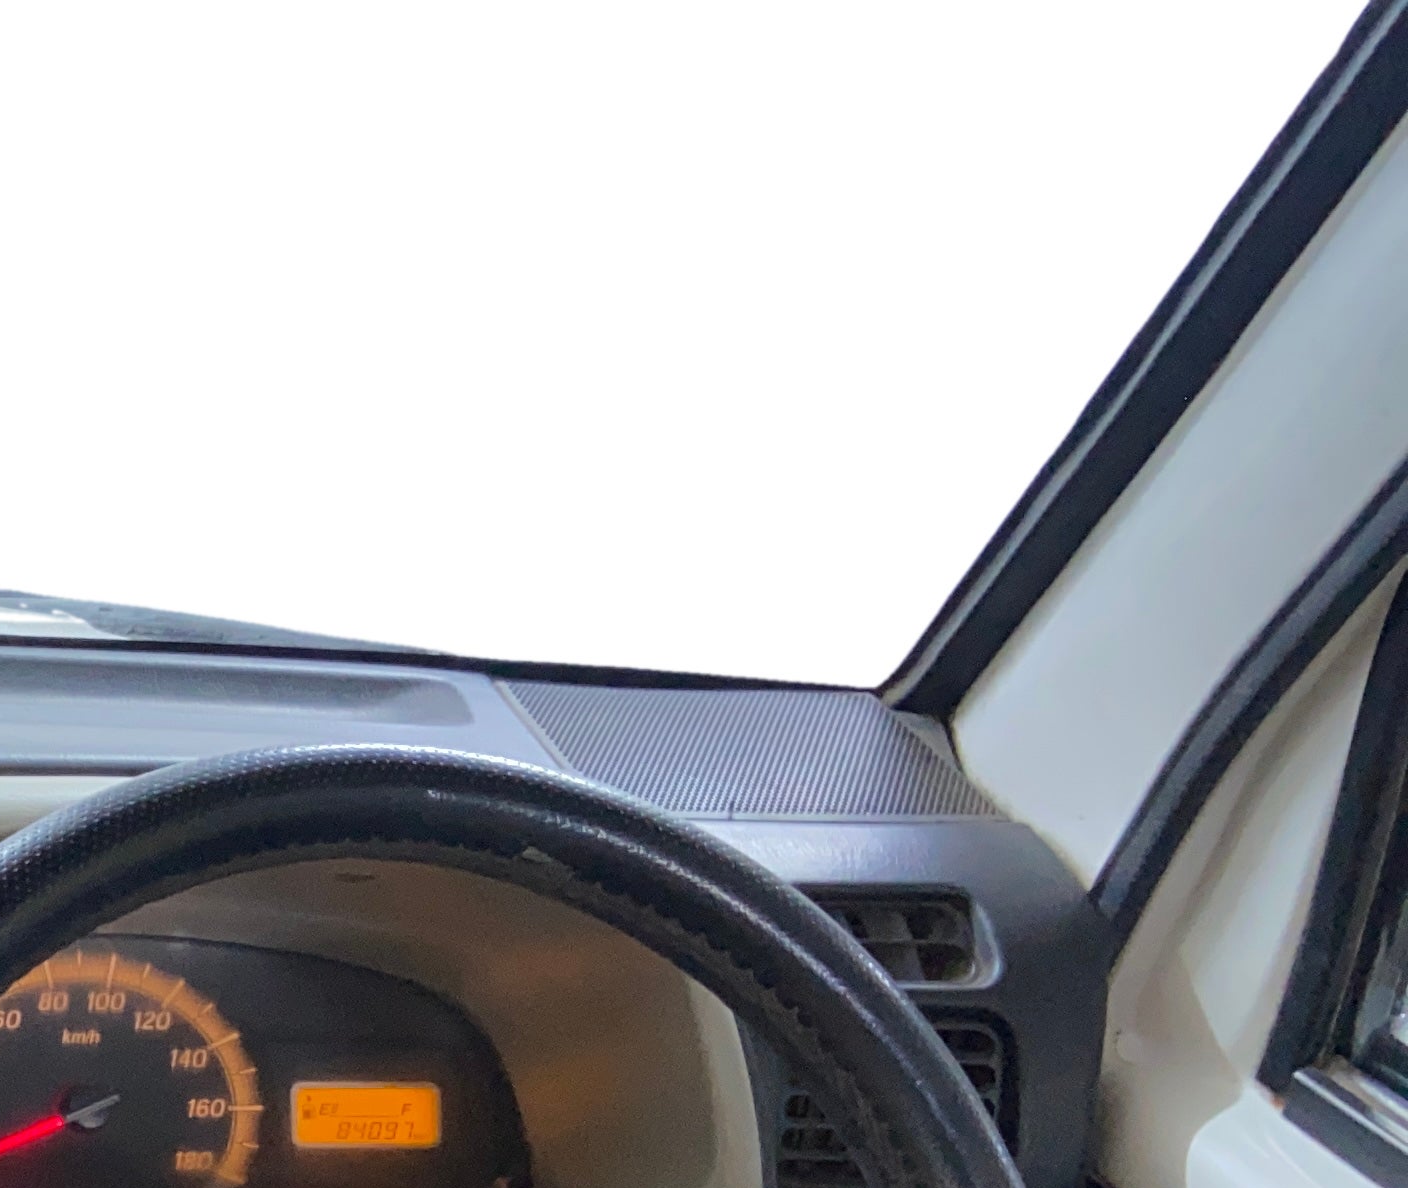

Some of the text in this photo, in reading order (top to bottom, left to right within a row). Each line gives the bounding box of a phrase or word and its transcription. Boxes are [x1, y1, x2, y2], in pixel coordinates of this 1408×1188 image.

[38, 992, 68, 1013] 80
[87, 992, 125, 1013] 100
[134, 1011, 170, 1031] 120
[62, 1029, 101, 1045] km/h
[170, 1049, 207, 1069] 140
[188, 1099, 225, 1118] 160
[401, 1103, 413, 1116] F
[336, 1121, 415, 1140] 84097
[175, 1151, 213, 1171] 180
